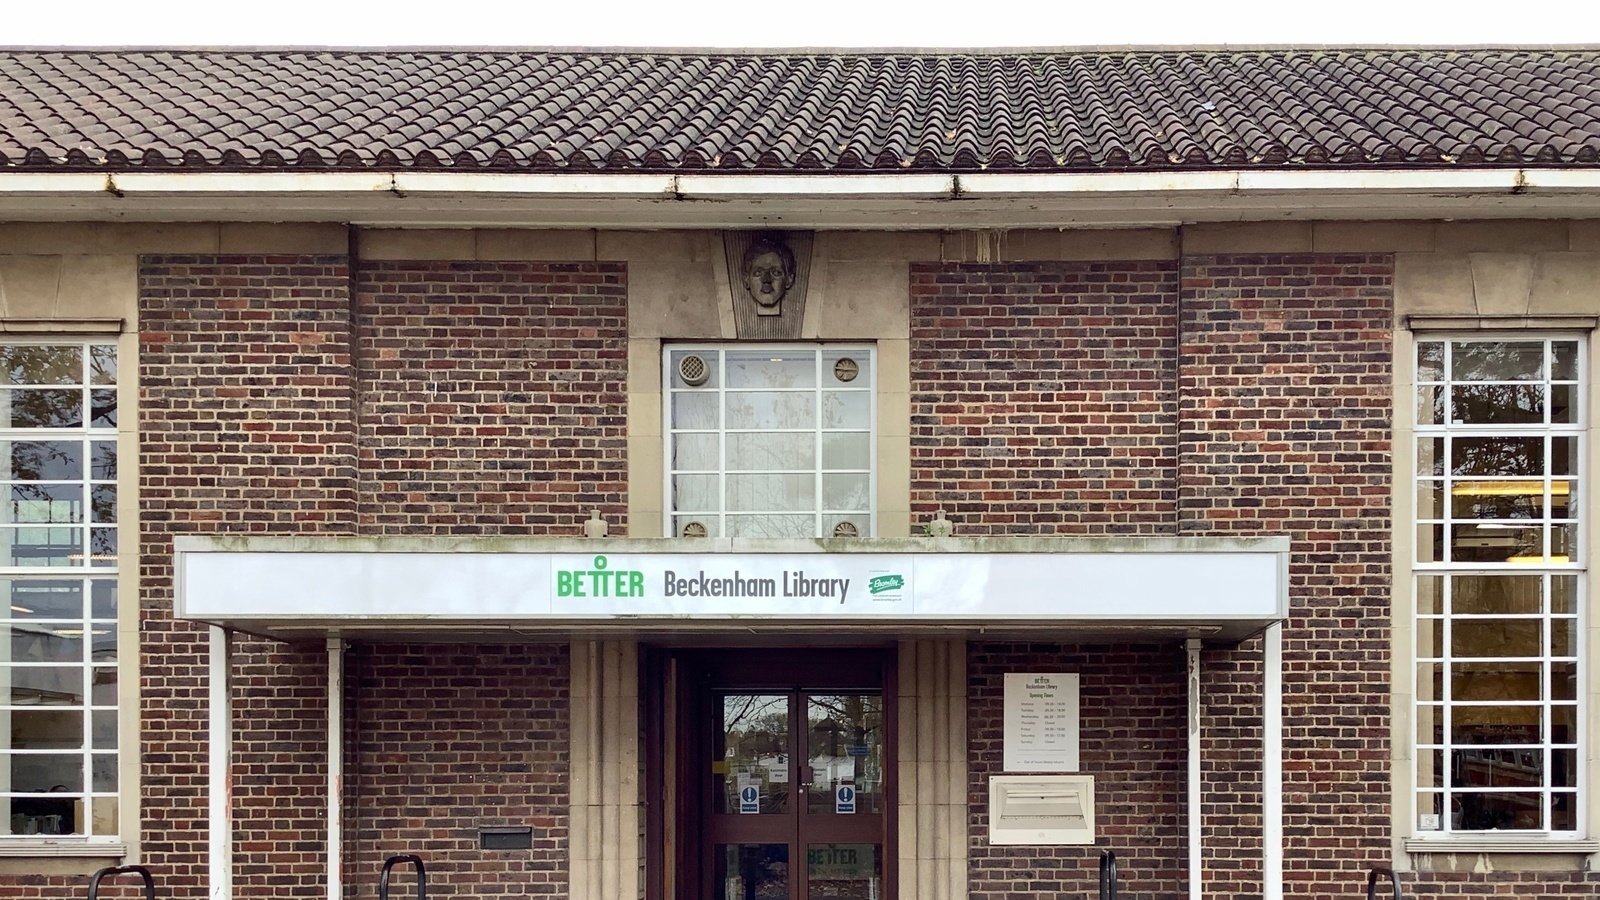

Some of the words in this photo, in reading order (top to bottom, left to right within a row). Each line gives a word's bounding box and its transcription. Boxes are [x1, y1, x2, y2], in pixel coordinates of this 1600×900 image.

[557, 570, 644, 598] BETTER
[664, 570, 775, 598] Beckenham
[783, 570, 850, 604] Library
[809, 849, 857, 865] BETTER
